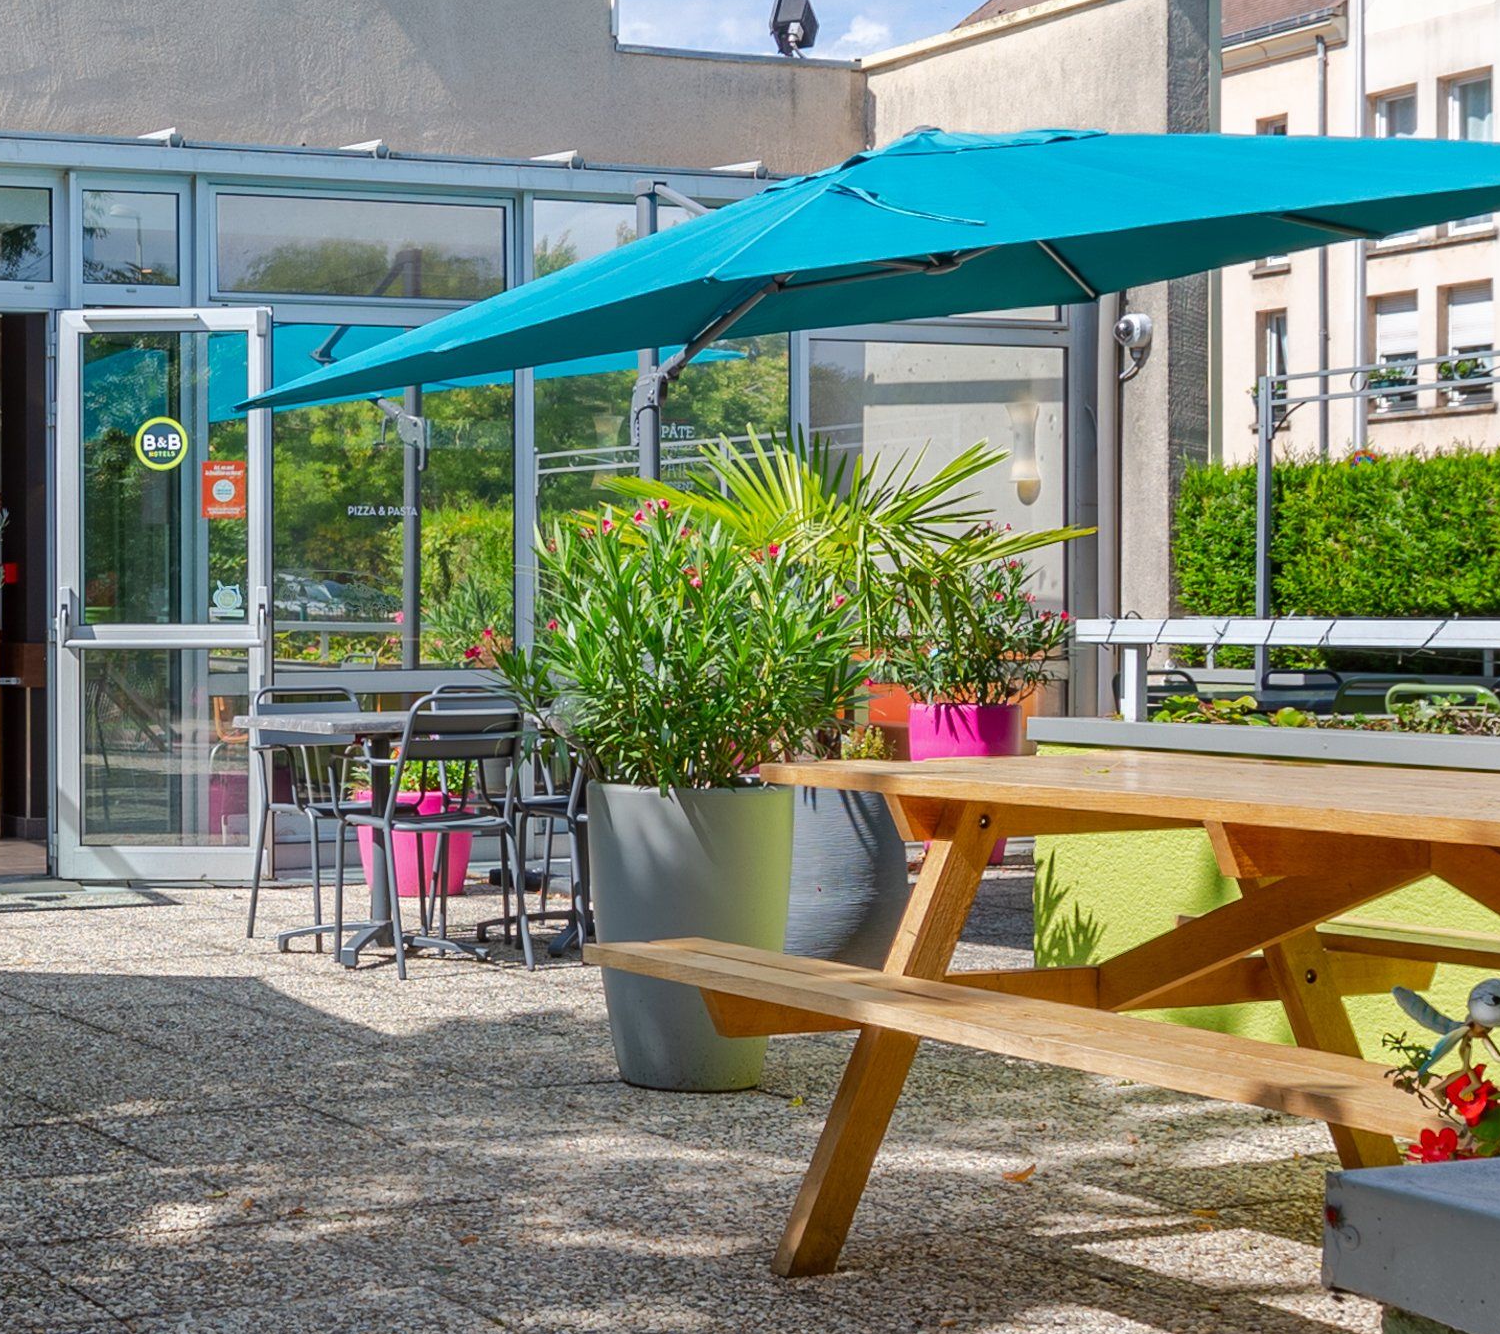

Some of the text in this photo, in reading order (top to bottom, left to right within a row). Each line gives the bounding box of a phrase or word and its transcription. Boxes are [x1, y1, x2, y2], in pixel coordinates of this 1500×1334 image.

[661, 422, 695, 439] PÂTE
[143, 433, 181, 451] B&B
[347, 505, 418, 516] PIZZA & PASTA
